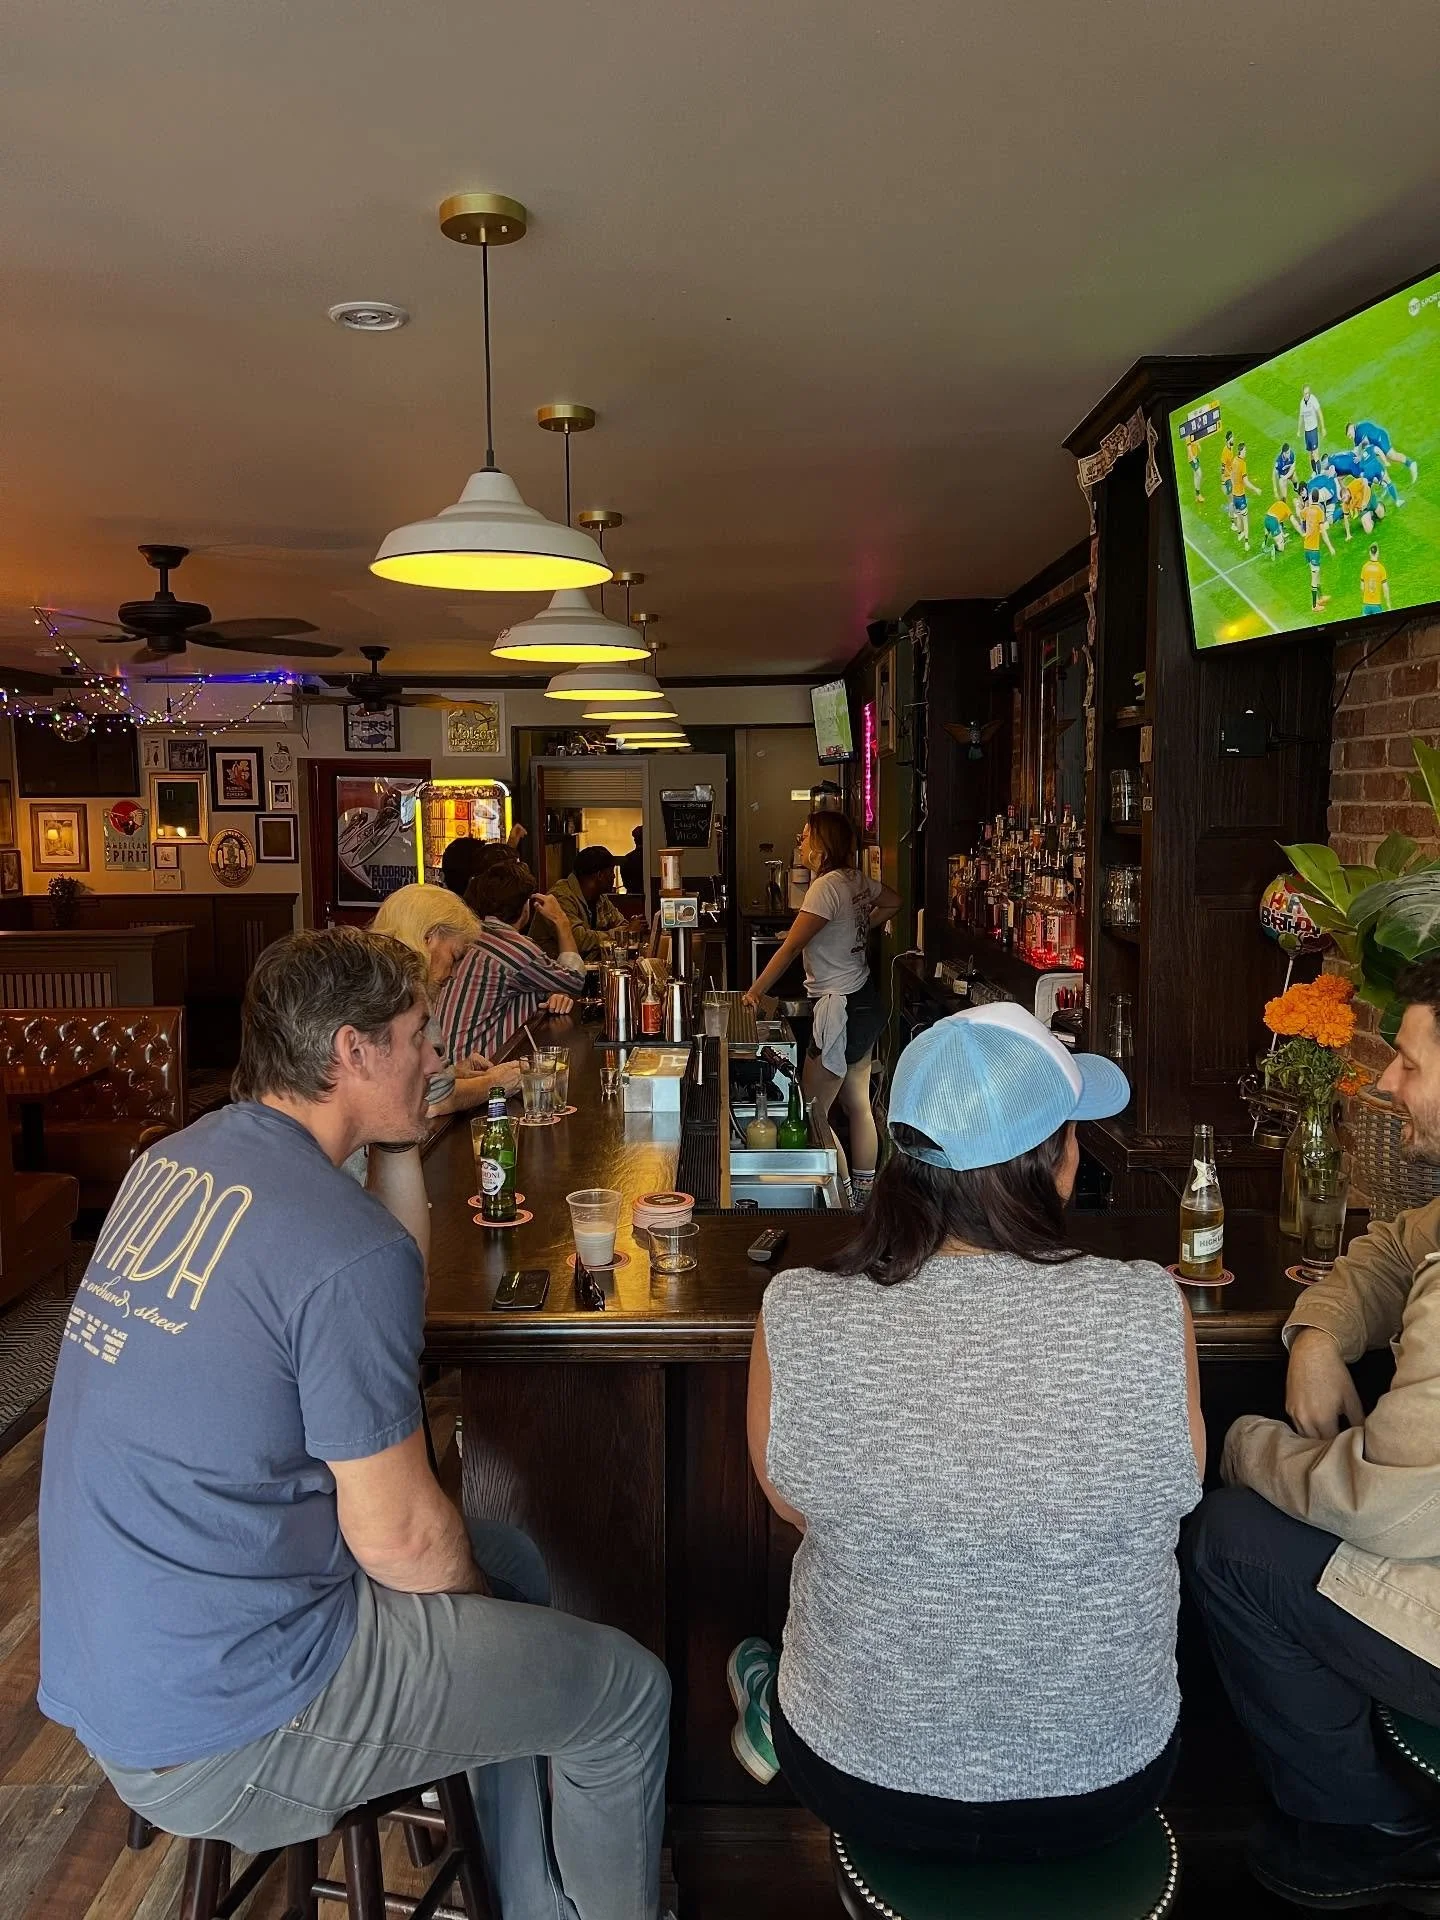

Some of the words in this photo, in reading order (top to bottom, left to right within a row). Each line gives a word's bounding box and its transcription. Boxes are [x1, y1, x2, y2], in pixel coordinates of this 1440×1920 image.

[351, 721, 392, 731] PEPSI
[363, 865, 417, 878] VELODROM
[1199, 1237, 1217, 1247] HIGH
[133, 1305, 188, 1336] street
